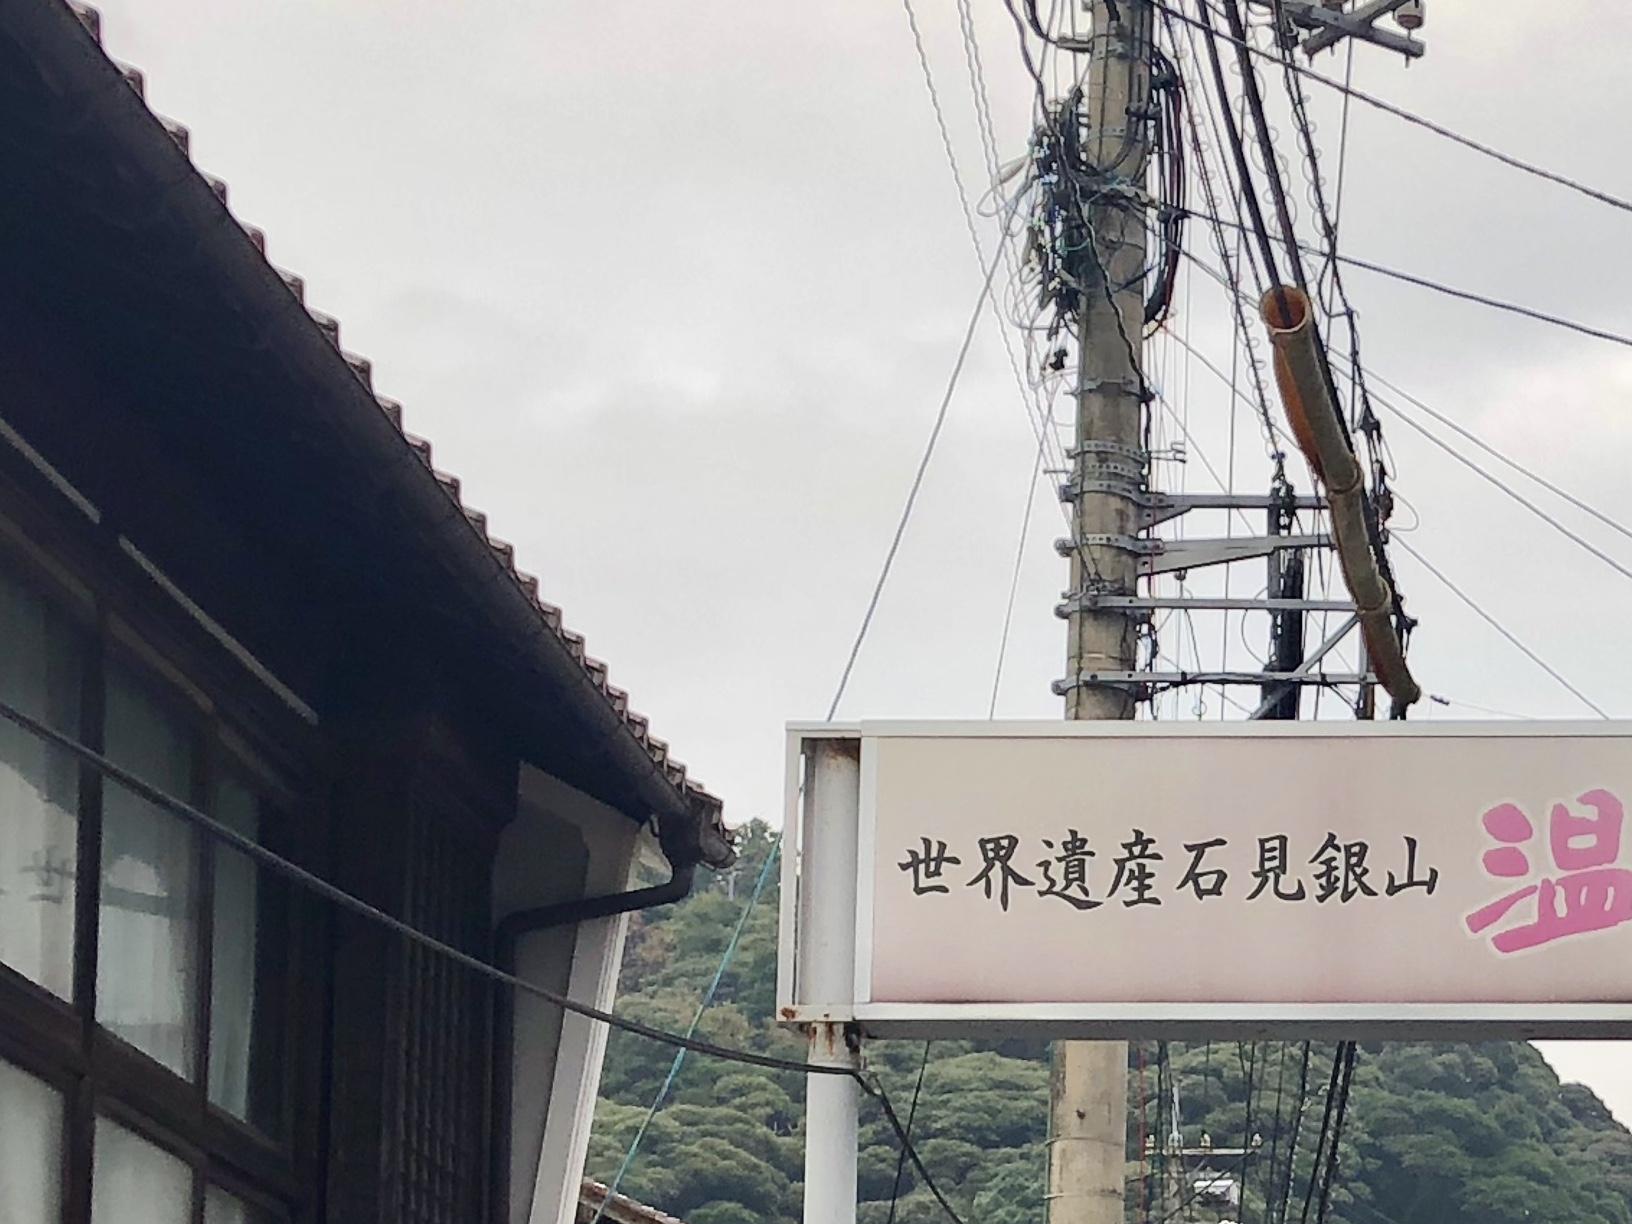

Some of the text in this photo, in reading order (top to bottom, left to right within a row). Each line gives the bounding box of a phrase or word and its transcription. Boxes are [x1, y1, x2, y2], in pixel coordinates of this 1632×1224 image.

[896, 828, 1438, 912] 世界遺産石見銀山
